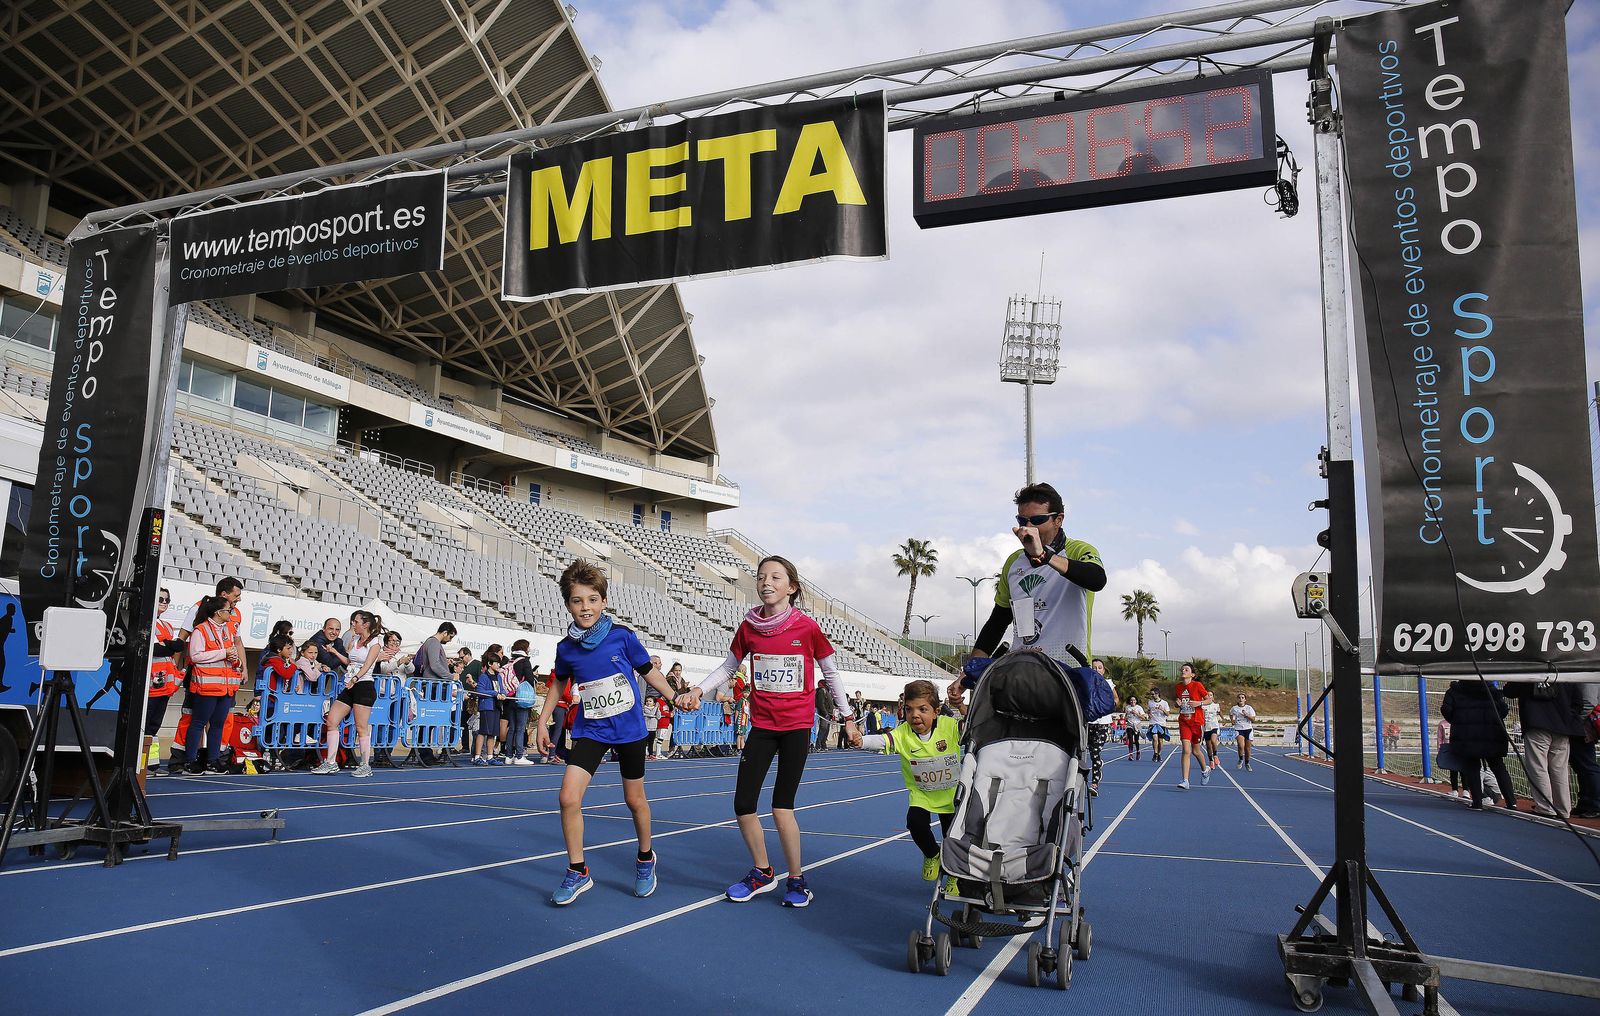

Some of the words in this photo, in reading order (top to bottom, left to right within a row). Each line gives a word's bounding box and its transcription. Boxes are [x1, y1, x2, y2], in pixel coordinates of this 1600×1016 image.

[1378, 40, 1415, 179] deportivos
[1414, 16, 1482, 255] Tempo
[529, 120, 868, 251] META
[180, 258, 265, 280] Cronometraje
[268, 255, 285, 269] de
[287, 247, 339, 265] eventos
[342, 237, 419, 260] deportivos
[183, 203, 426, 261] www.temposport.es
[1392, 186, 1426, 295] eventos
[74, 257, 94, 350] deportivos
[82, 249, 117, 399] Tempo
[1403, 302, 1431, 337] de
[62, 354, 82, 422] eventos
[272, 360, 313, 379] Ayuntamiento
[321, 377, 342, 391] Málaga
[57, 427, 69, 450] de
[437, 417, 468, 432] Ayuntamiento
[1413, 345, 1443, 545] Cronometraje
[40, 454, 67, 579] Cronometraje
[1393, 622, 1454, 653] 620
[1464, 621, 1526, 653] 998
[1536, 619, 1597, 652] 733
[591, 690, 624, 710] 2062
[763, 669, 793, 683] 4575
[921, 768, 952, 784] 3075
